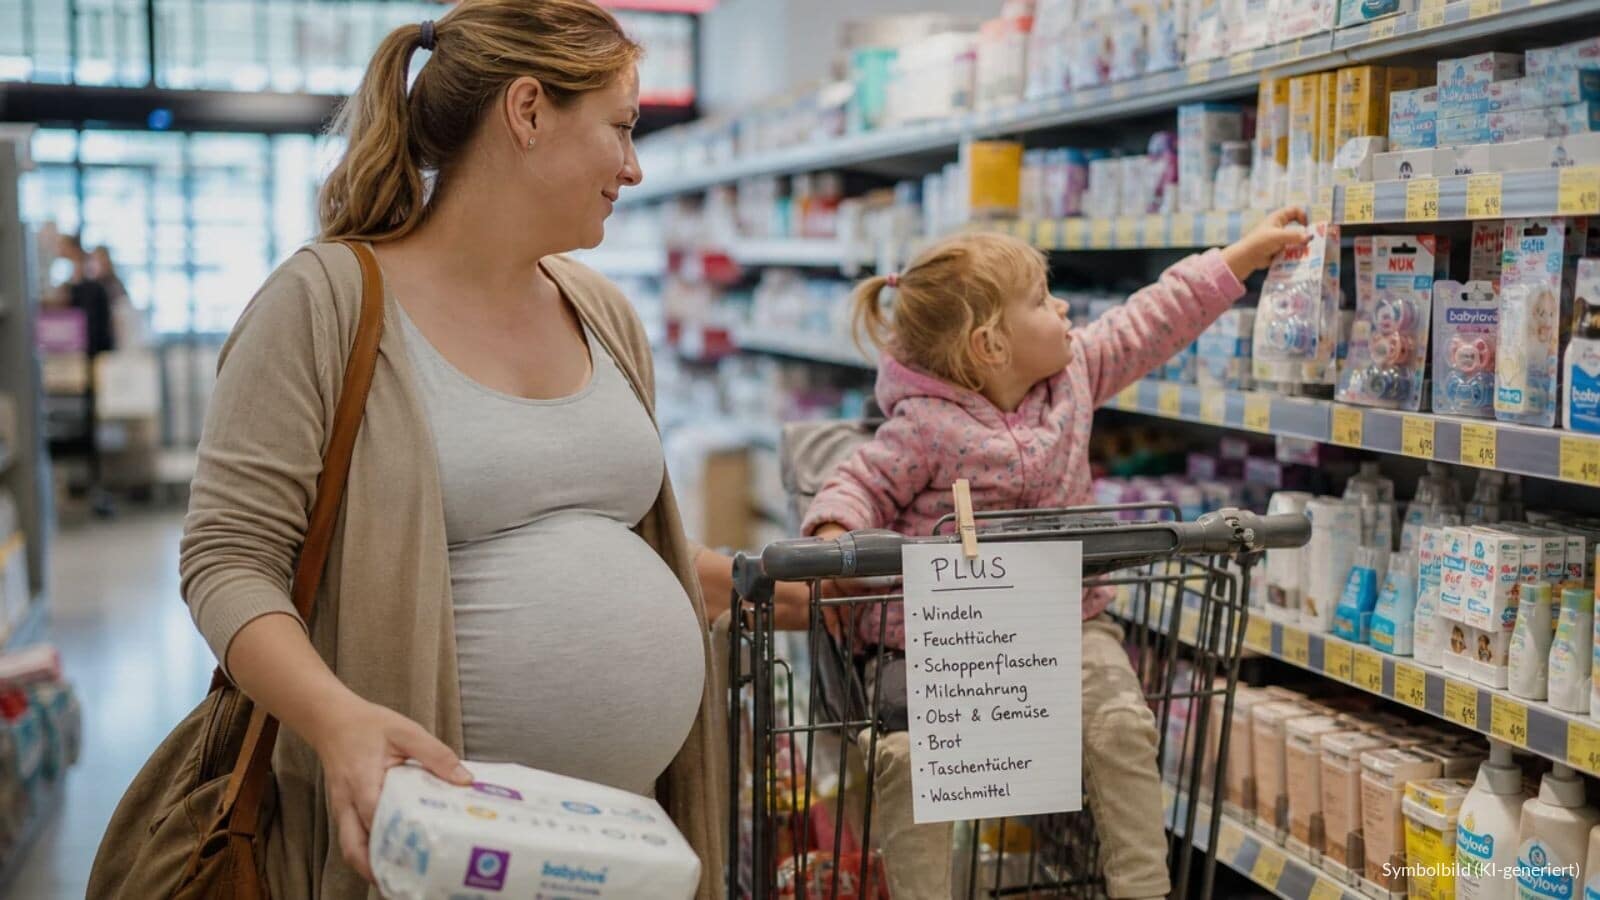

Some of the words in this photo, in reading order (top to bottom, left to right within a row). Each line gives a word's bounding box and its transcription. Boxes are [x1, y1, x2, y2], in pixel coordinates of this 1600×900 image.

[1388, 257, 1415, 271] NUK
[931, 556, 1007, 582] PLUS
[922, 605, 983, 621] Windeln
[923, 630, 1017, 647] Feuchttücher
[924, 653, 1058, 678] Schoppenflaschen
[925, 683, 1028, 702] Milchnahrung
[926, 708, 962, 724] Obst
[971, 709, 981, 721] &
[991, 705, 1050, 721] Gemüse
[927, 733, 963, 750] Brot
[928, 757, 1032, 775] Taschentücher
[930, 783, 1011, 803] Waschmittel
